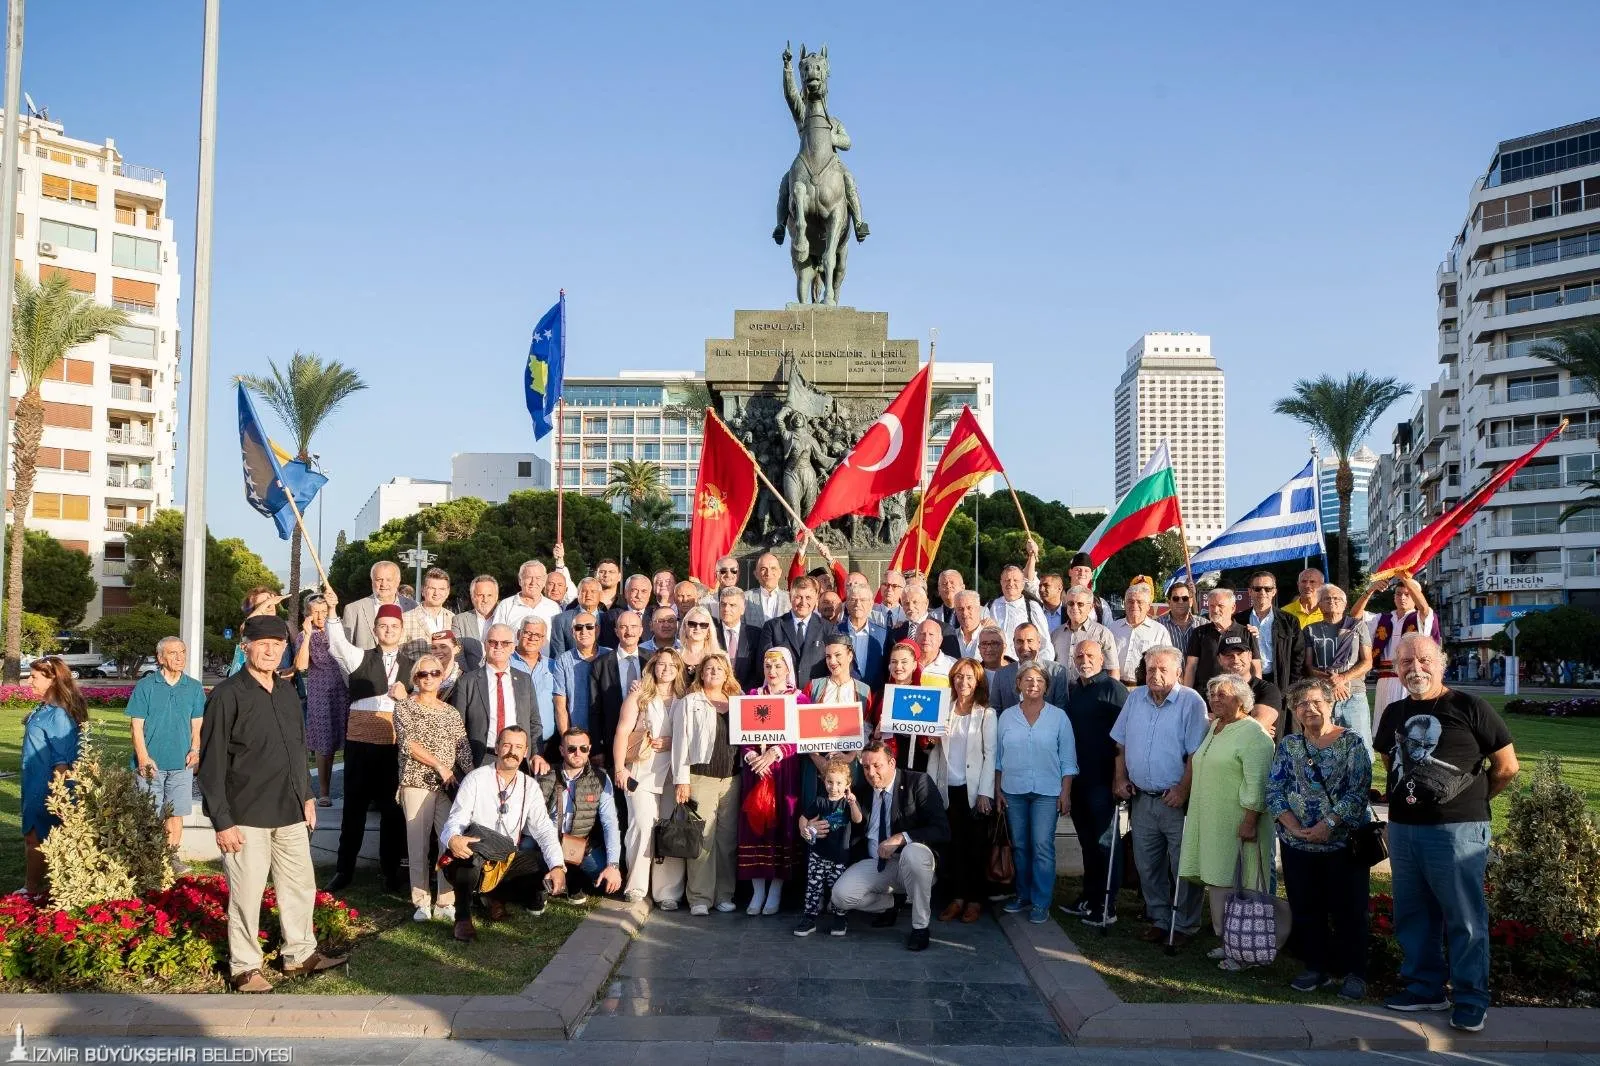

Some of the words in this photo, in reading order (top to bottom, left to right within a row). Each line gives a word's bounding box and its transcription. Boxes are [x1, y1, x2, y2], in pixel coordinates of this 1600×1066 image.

[749, 321, 806, 331] ORDULAR!
[1503, 576, 1543, 584] RENGİN
[892, 722, 936, 735] KOSOVO
[740, 733, 787, 743] ALBANIA
[799, 741, 863, 752] MONTENEGRO
